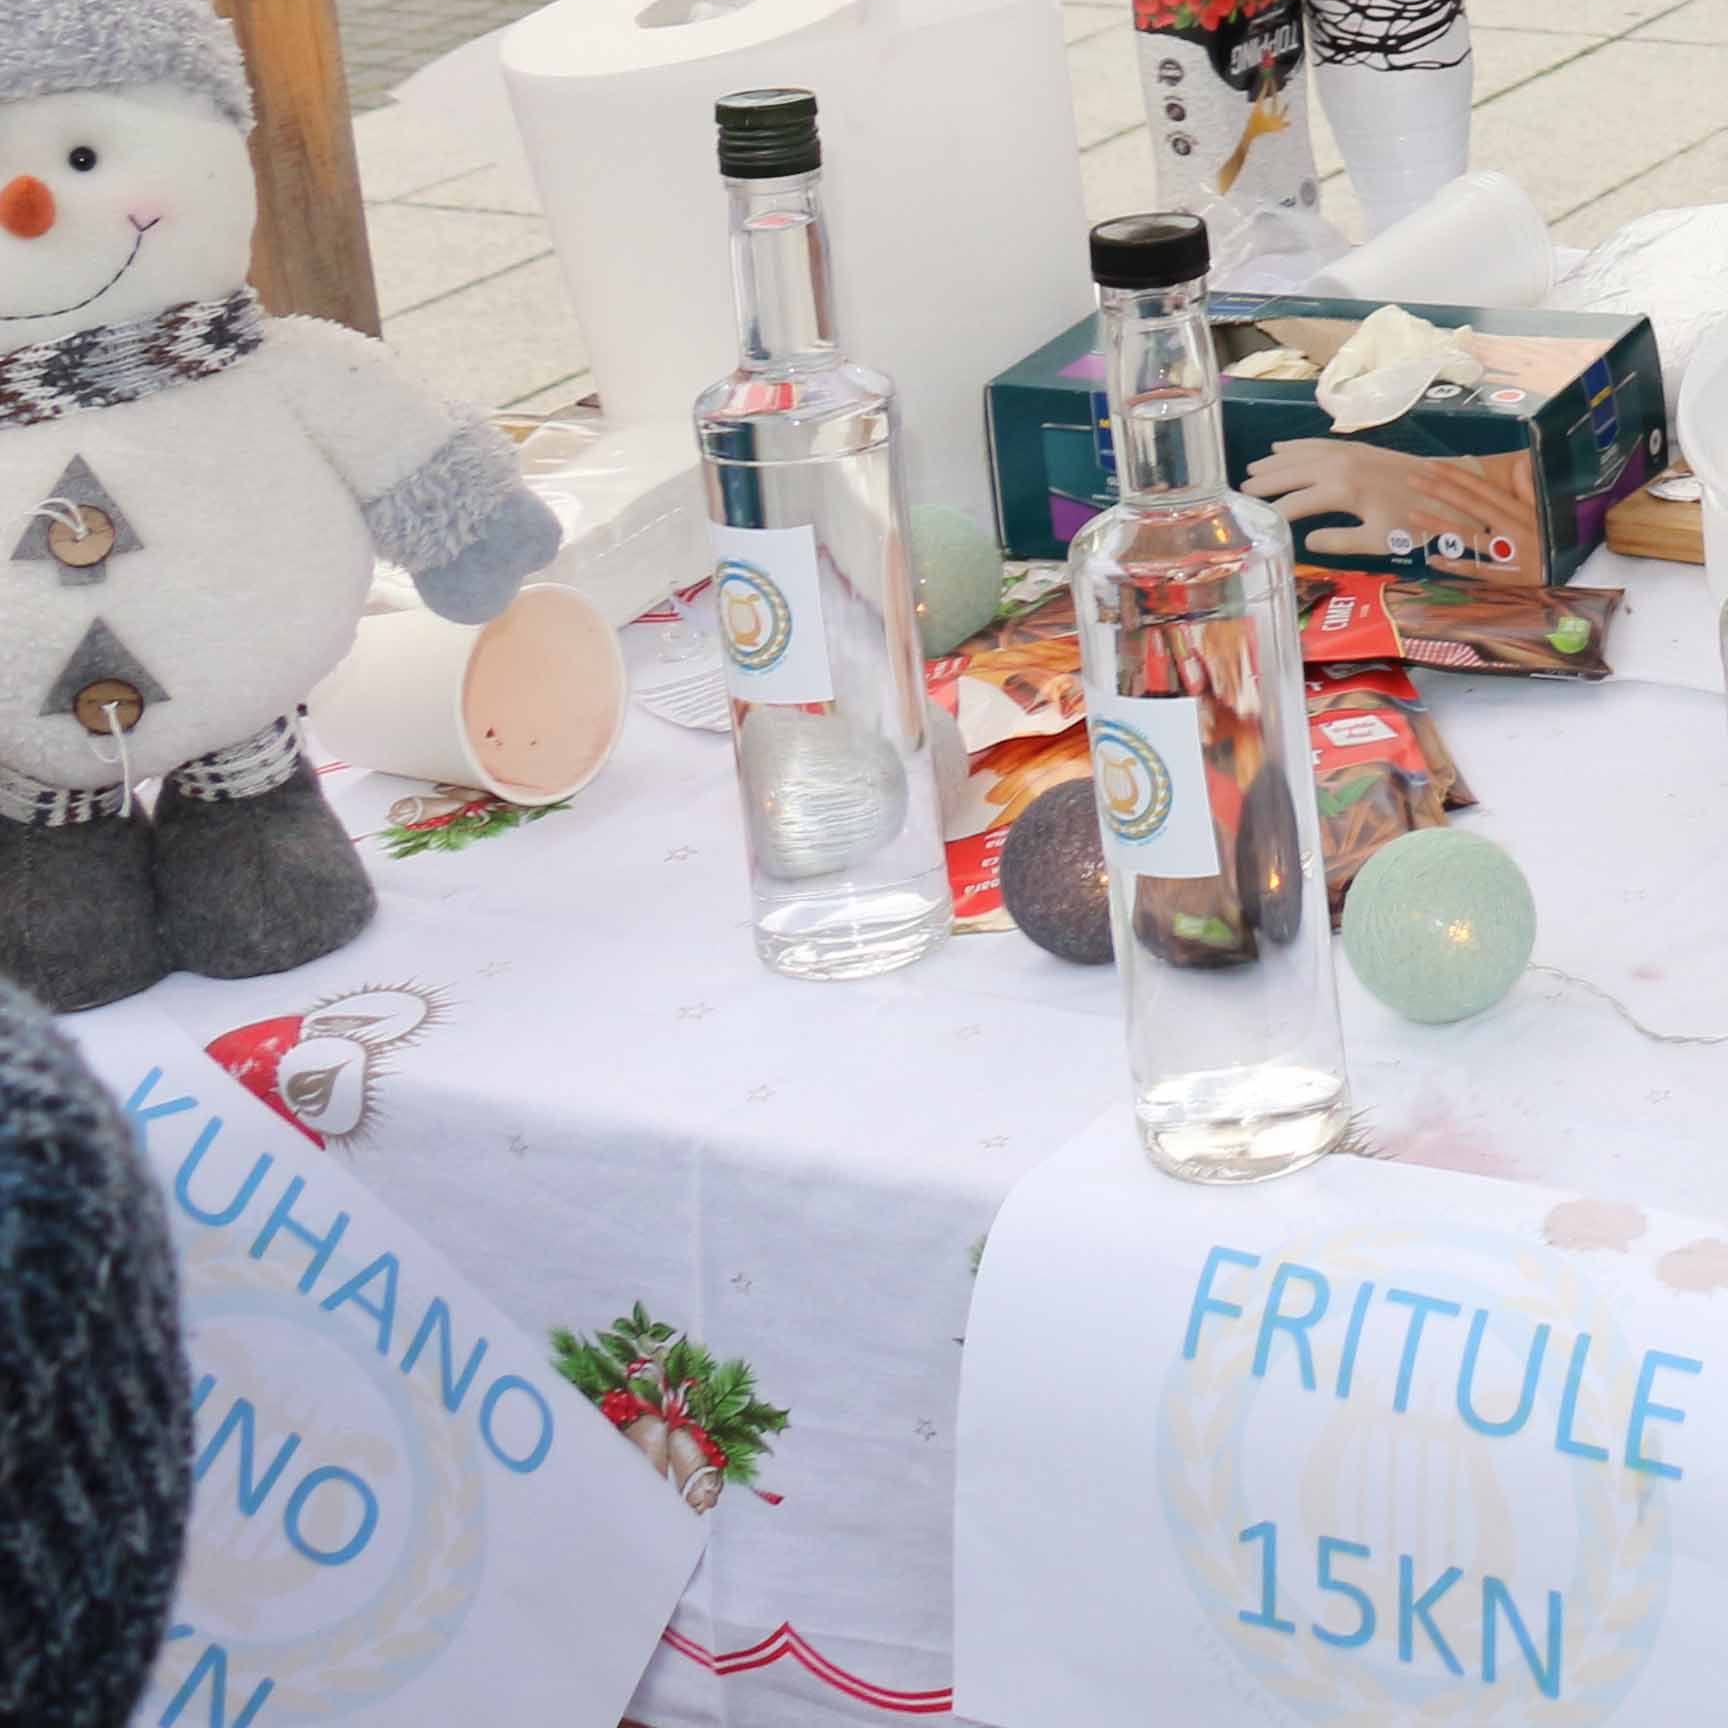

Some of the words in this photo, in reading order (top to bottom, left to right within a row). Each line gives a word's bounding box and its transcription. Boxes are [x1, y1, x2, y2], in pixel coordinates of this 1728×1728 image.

[1320, 596, 1357, 632] CIMET
[127, 1066, 555, 1474] KUHANO
[1183, 1245, 1703, 1481] FRITULE
[1238, 1521, 1563, 1700] 15KN
